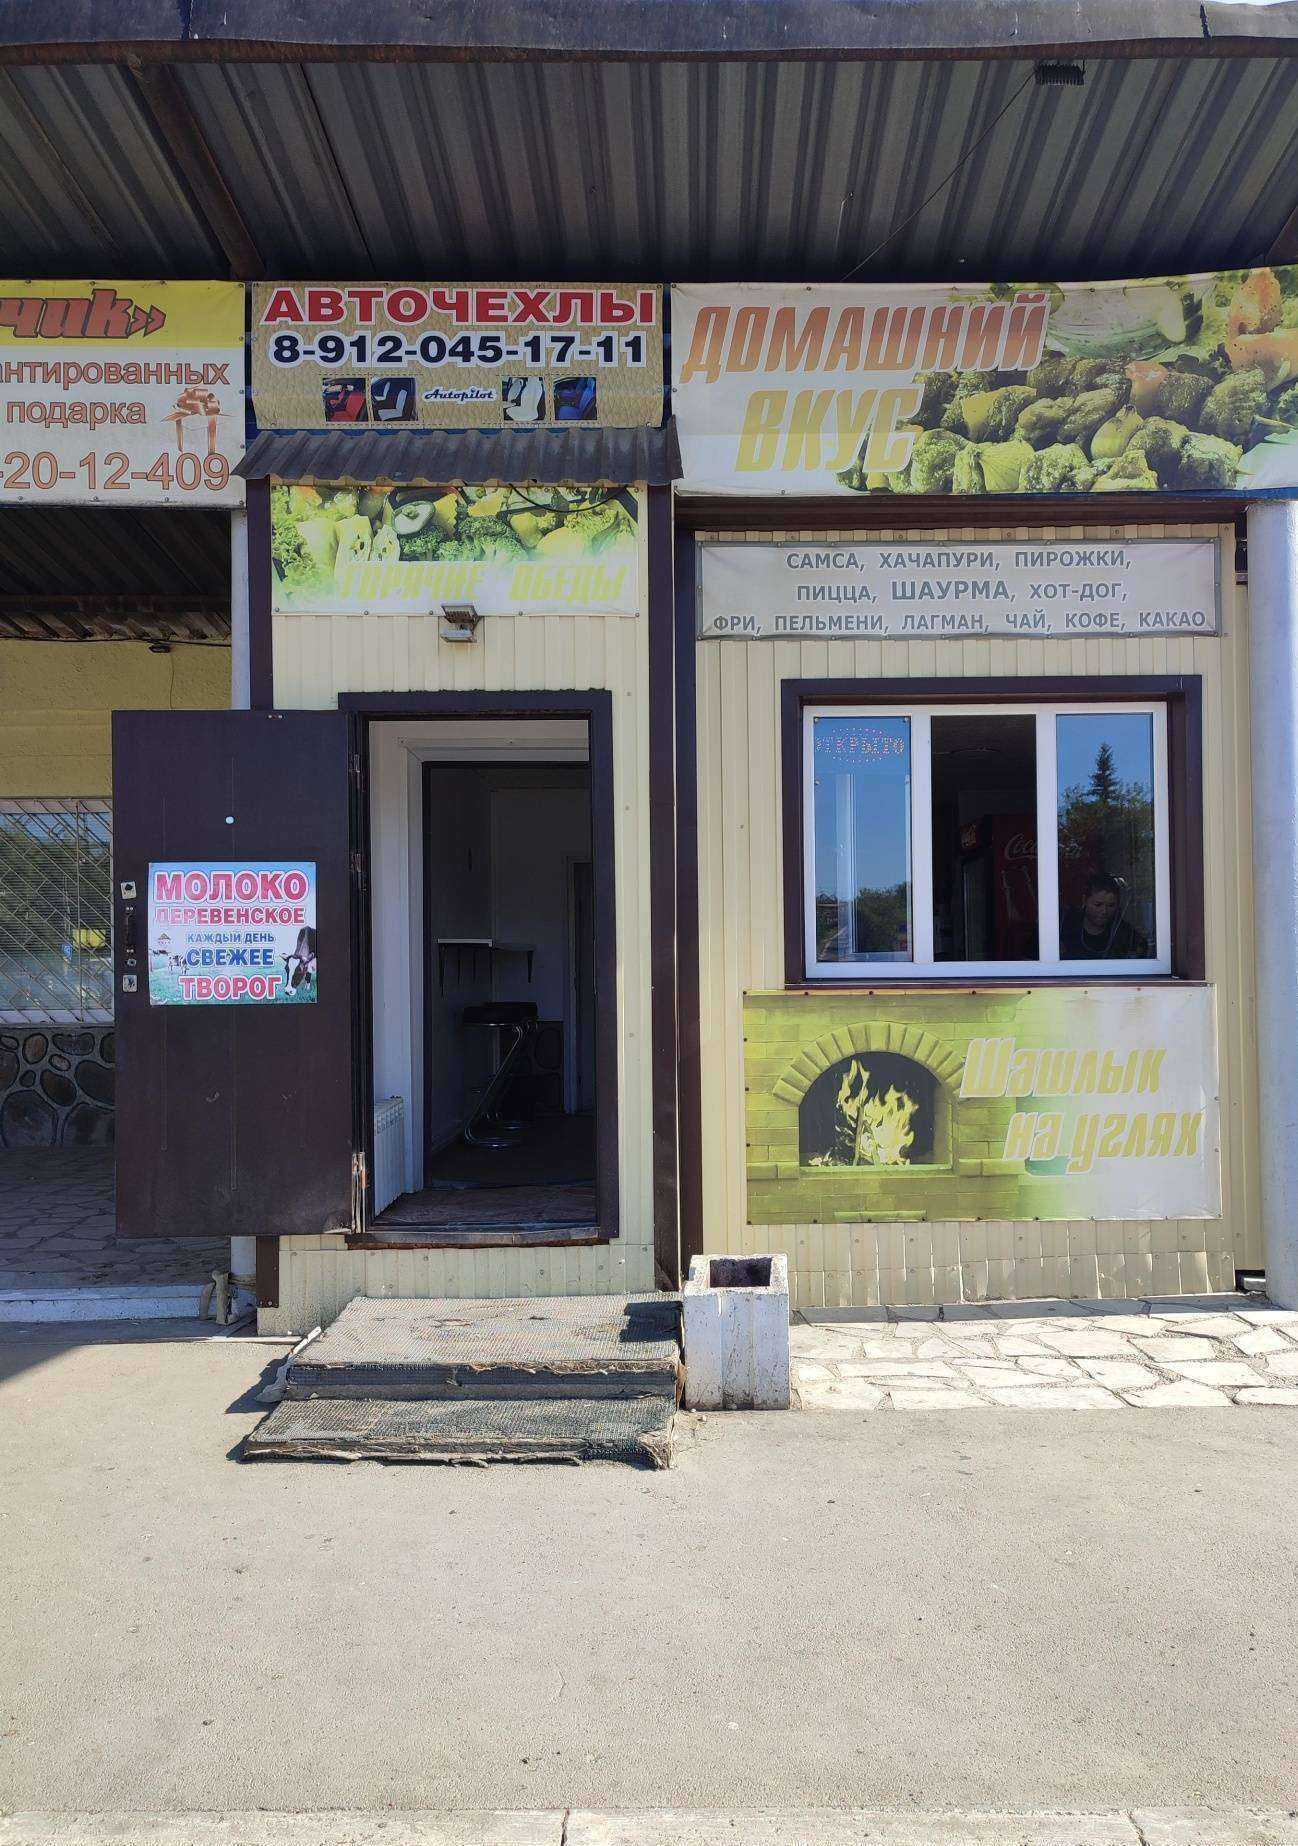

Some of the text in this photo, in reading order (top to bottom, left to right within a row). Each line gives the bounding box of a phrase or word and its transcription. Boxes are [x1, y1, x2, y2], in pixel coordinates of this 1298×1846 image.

[262, 288, 656, 324] АВТОЧЕХЛЫ
[272, 334, 645, 364] 8-912-045-17-11
[680, 292, 1050, 384] ДОМАШНИЙ
[0, 361, 230, 390] нтированных
[424, 387, 494, 403] Autopilot
[6, 401, 147, 430] подарка
[734, 388, 923, 474] ВКУС
[0, 451, 230, 491] 20-12-409
[786, 550, 1131, 571] САМСА, ХАЧАПУРИ, ПИРОЖКИ,
[797, 580, 1128, 604] ПИЦЦА, ШАУРМА, ХОТ-ДОГ,
[713, 608, 1206, 634] ФРИ, ПЕЛЬМЕНИ, ЛАГМАН, ЧАЙ, КОФЕ, КАКАО
[155, 871, 309, 903] МОЛОКО
[244, 932, 275, 944] ДЕНЬ
[186, 948, 274, 966] СВЕЖЕЕ
[179, 975, 282, 1000] ТВОРОГ
[960, 1038, 1166, 1097] Шашлык
[1003, 1112, 1202, 1174] на углях
